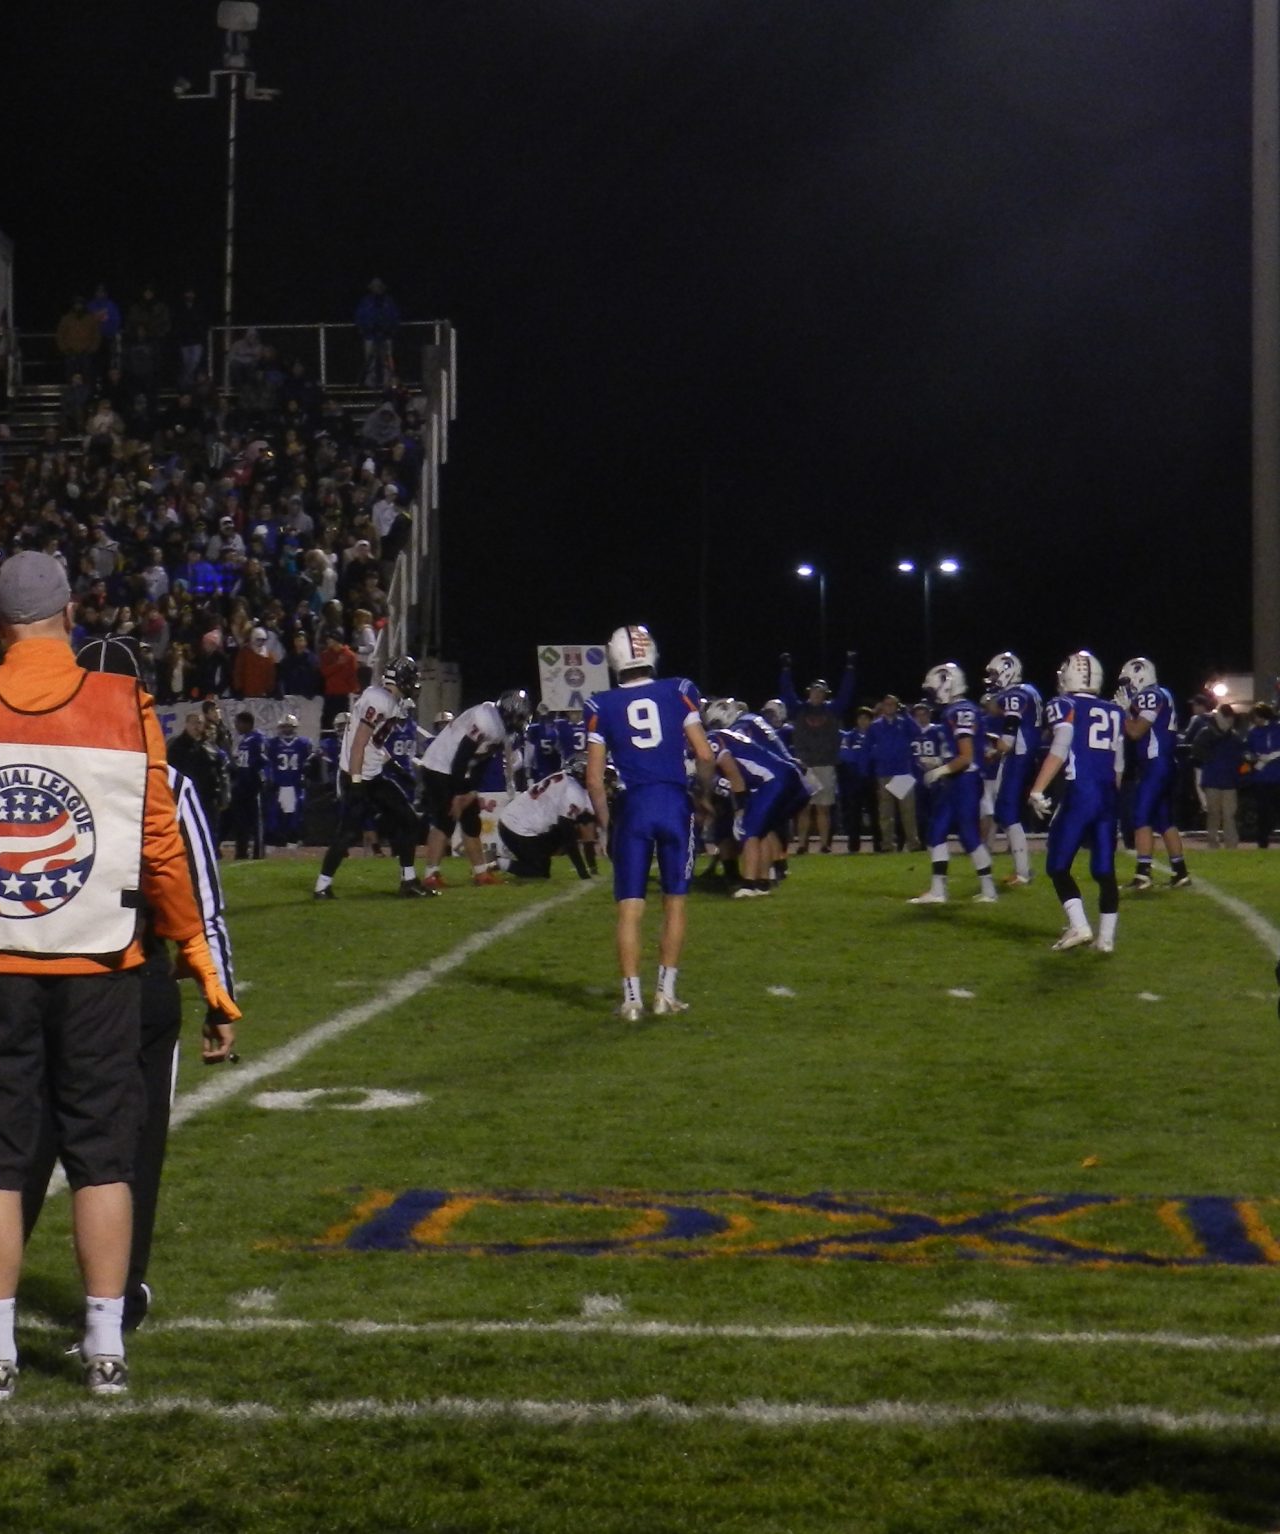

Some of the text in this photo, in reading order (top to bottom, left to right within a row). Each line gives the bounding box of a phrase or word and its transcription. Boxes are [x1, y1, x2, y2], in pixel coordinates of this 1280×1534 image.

[1004, 696, 1020, 710] 16
[1137, 692, 1157, 709] 22
[1045, 702, 1064, 723] 21
[627, 698, 663, 749] 9
[1088, 706, 1121, 751] 21
[910, 739, 936, 756] 38
[276, 752, 299, 771] 34
[38, 772, 95, 835] LEAGUE
